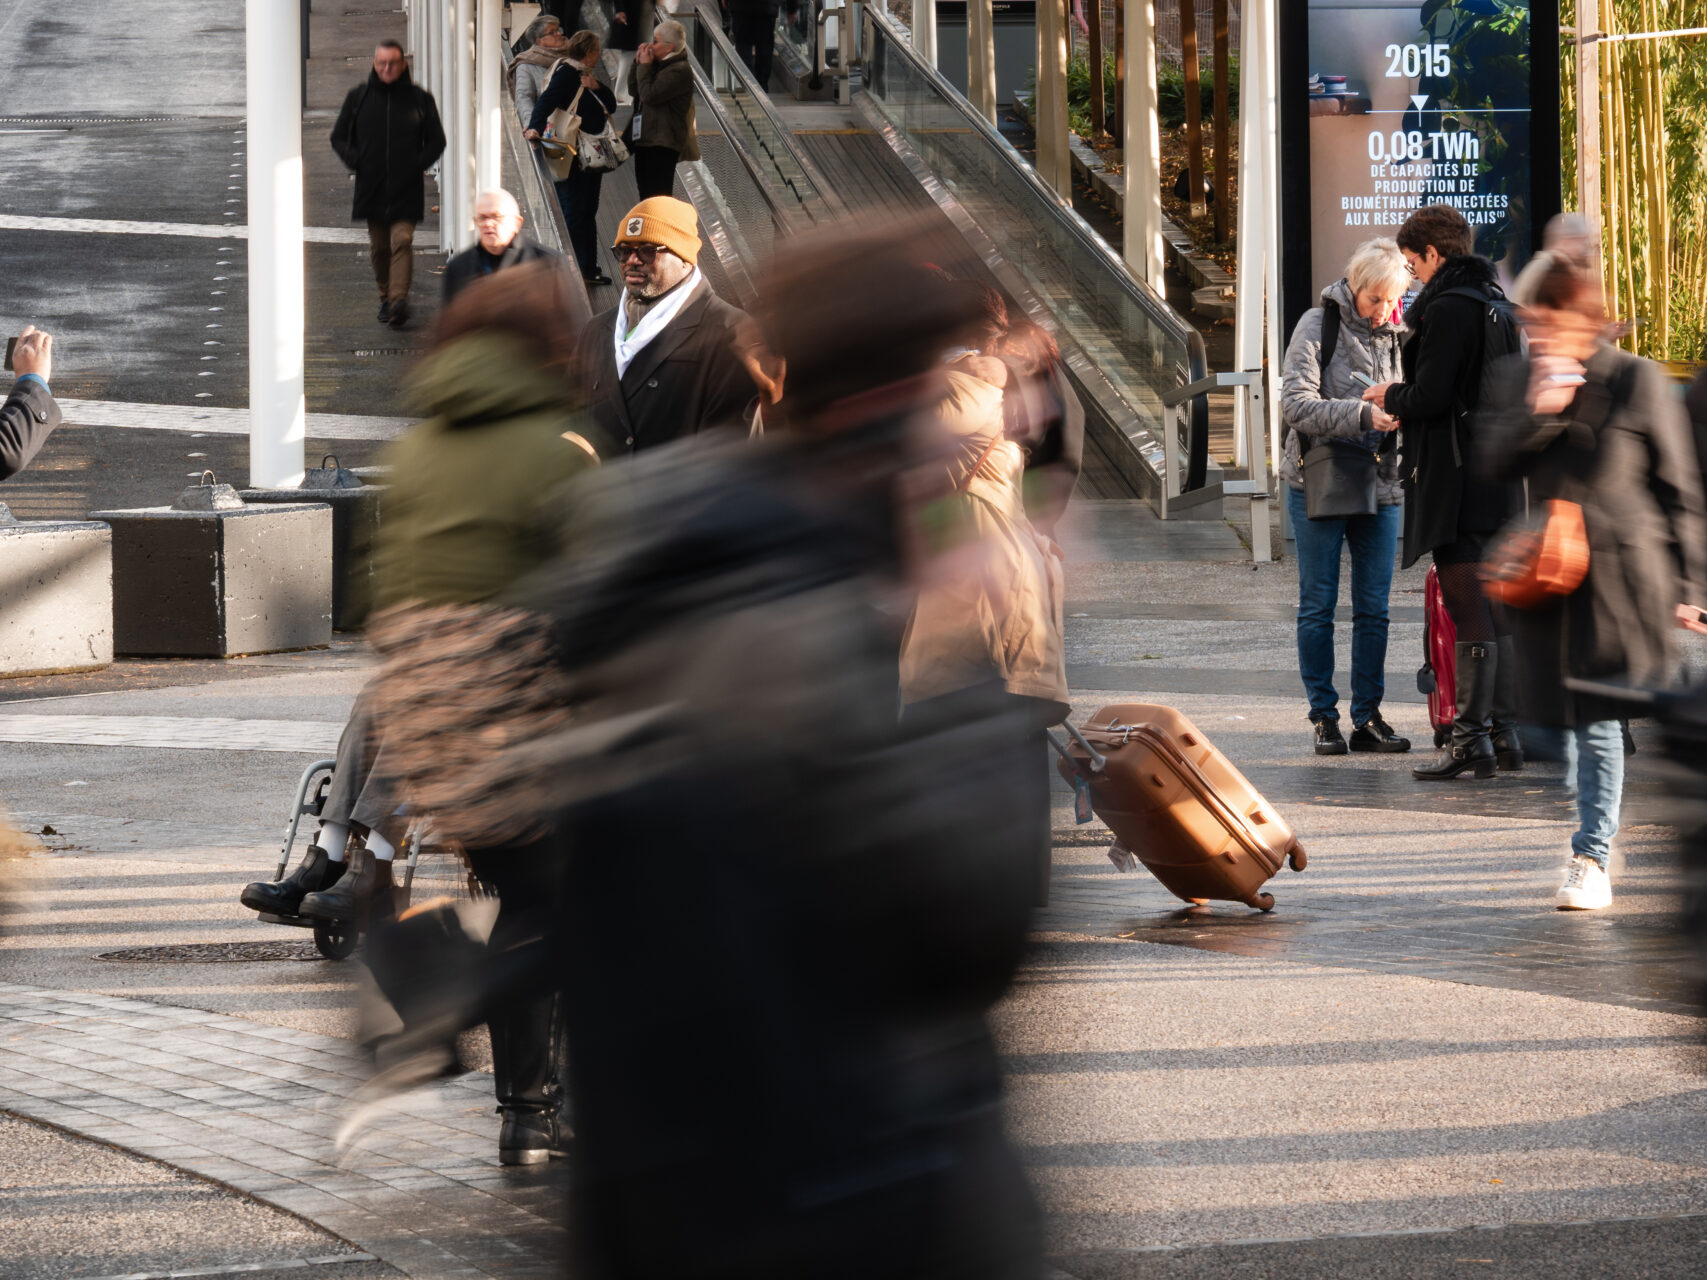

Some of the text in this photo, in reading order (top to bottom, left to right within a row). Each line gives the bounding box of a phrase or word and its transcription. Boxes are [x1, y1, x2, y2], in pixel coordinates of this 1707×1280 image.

[1385, 44, 1451, 78] 2015
[1368, 131, 1479, 165] 0,08 TWh
[1371, 161, 1478, 177] DE CAPACITÉS DE
[1375, 179, 1475, 193] PRODUCTION DE
[1341, 194, 1422, 210] BIOMÉTHANE
[1345, 213, 1370, 225] AUX
